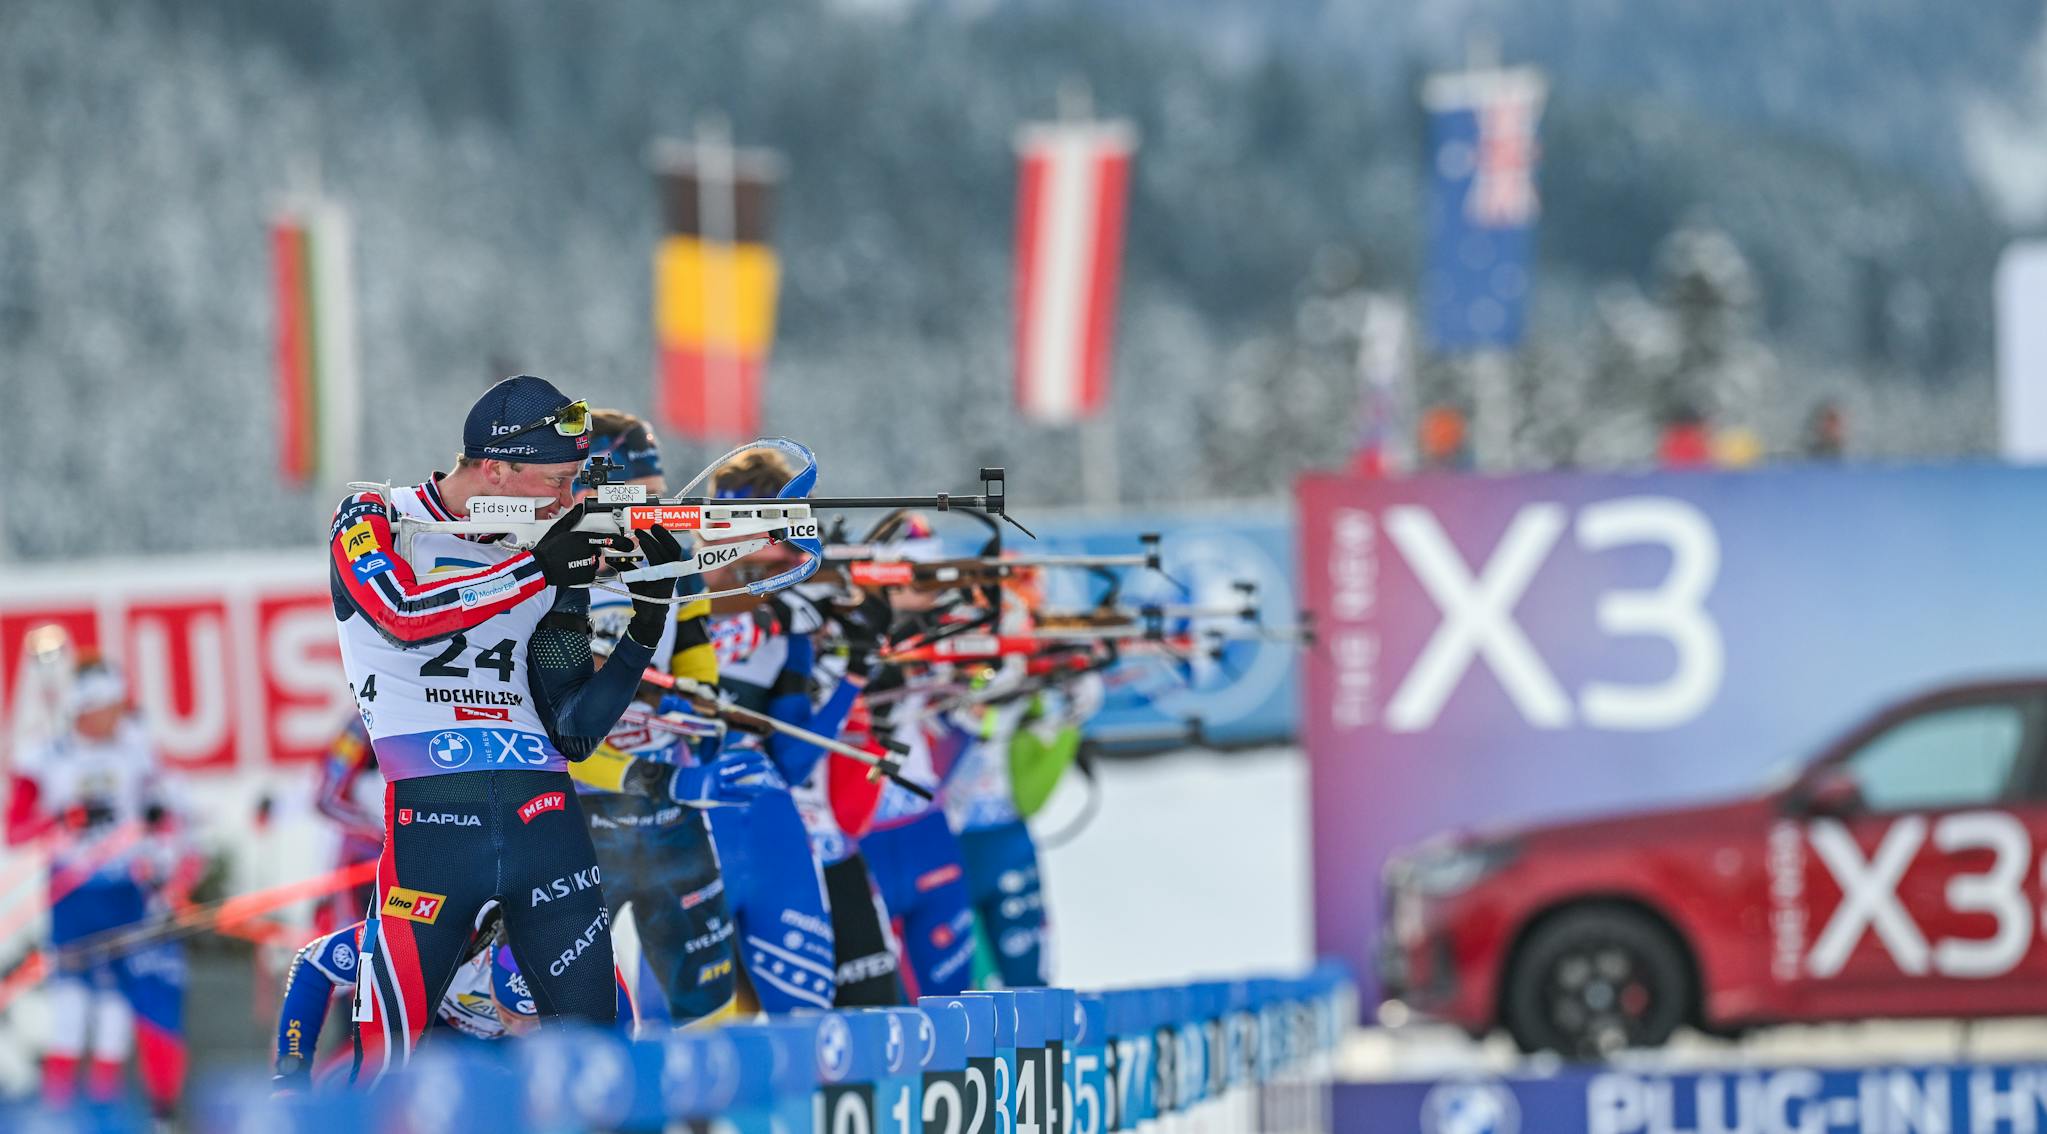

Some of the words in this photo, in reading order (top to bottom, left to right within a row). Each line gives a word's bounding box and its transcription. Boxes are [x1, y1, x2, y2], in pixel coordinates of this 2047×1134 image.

[484, 446, 525, 455] CRAFT
[604, 486, 640, 495] SANDNES
[610, 494, 634, 502] GARN
[329, 504, 370, 541] CRAFT
[632, 508, 699, 524] VIESSMANN
[790, 521, 816, 537] ice
[697, 547, 738, 570] JOKA
[479, 586, 504, 598] Monitor
[503, 580, 516, 592] ERP
[1382, 496, 1726, 733] X3
[419, 633, 518, 682] 24
[491, 730, 548, 765] X3
[523, 795, 562, 818] MENY
[416, 812, 482, 827] LAPUA
[388, 896, 412, 909] Uno
[1808, 810, 2035, 979] X3
[549, 913, 607, 978] CRAFT
[1586, 1070, 1950, 1134] PLUG-IN
